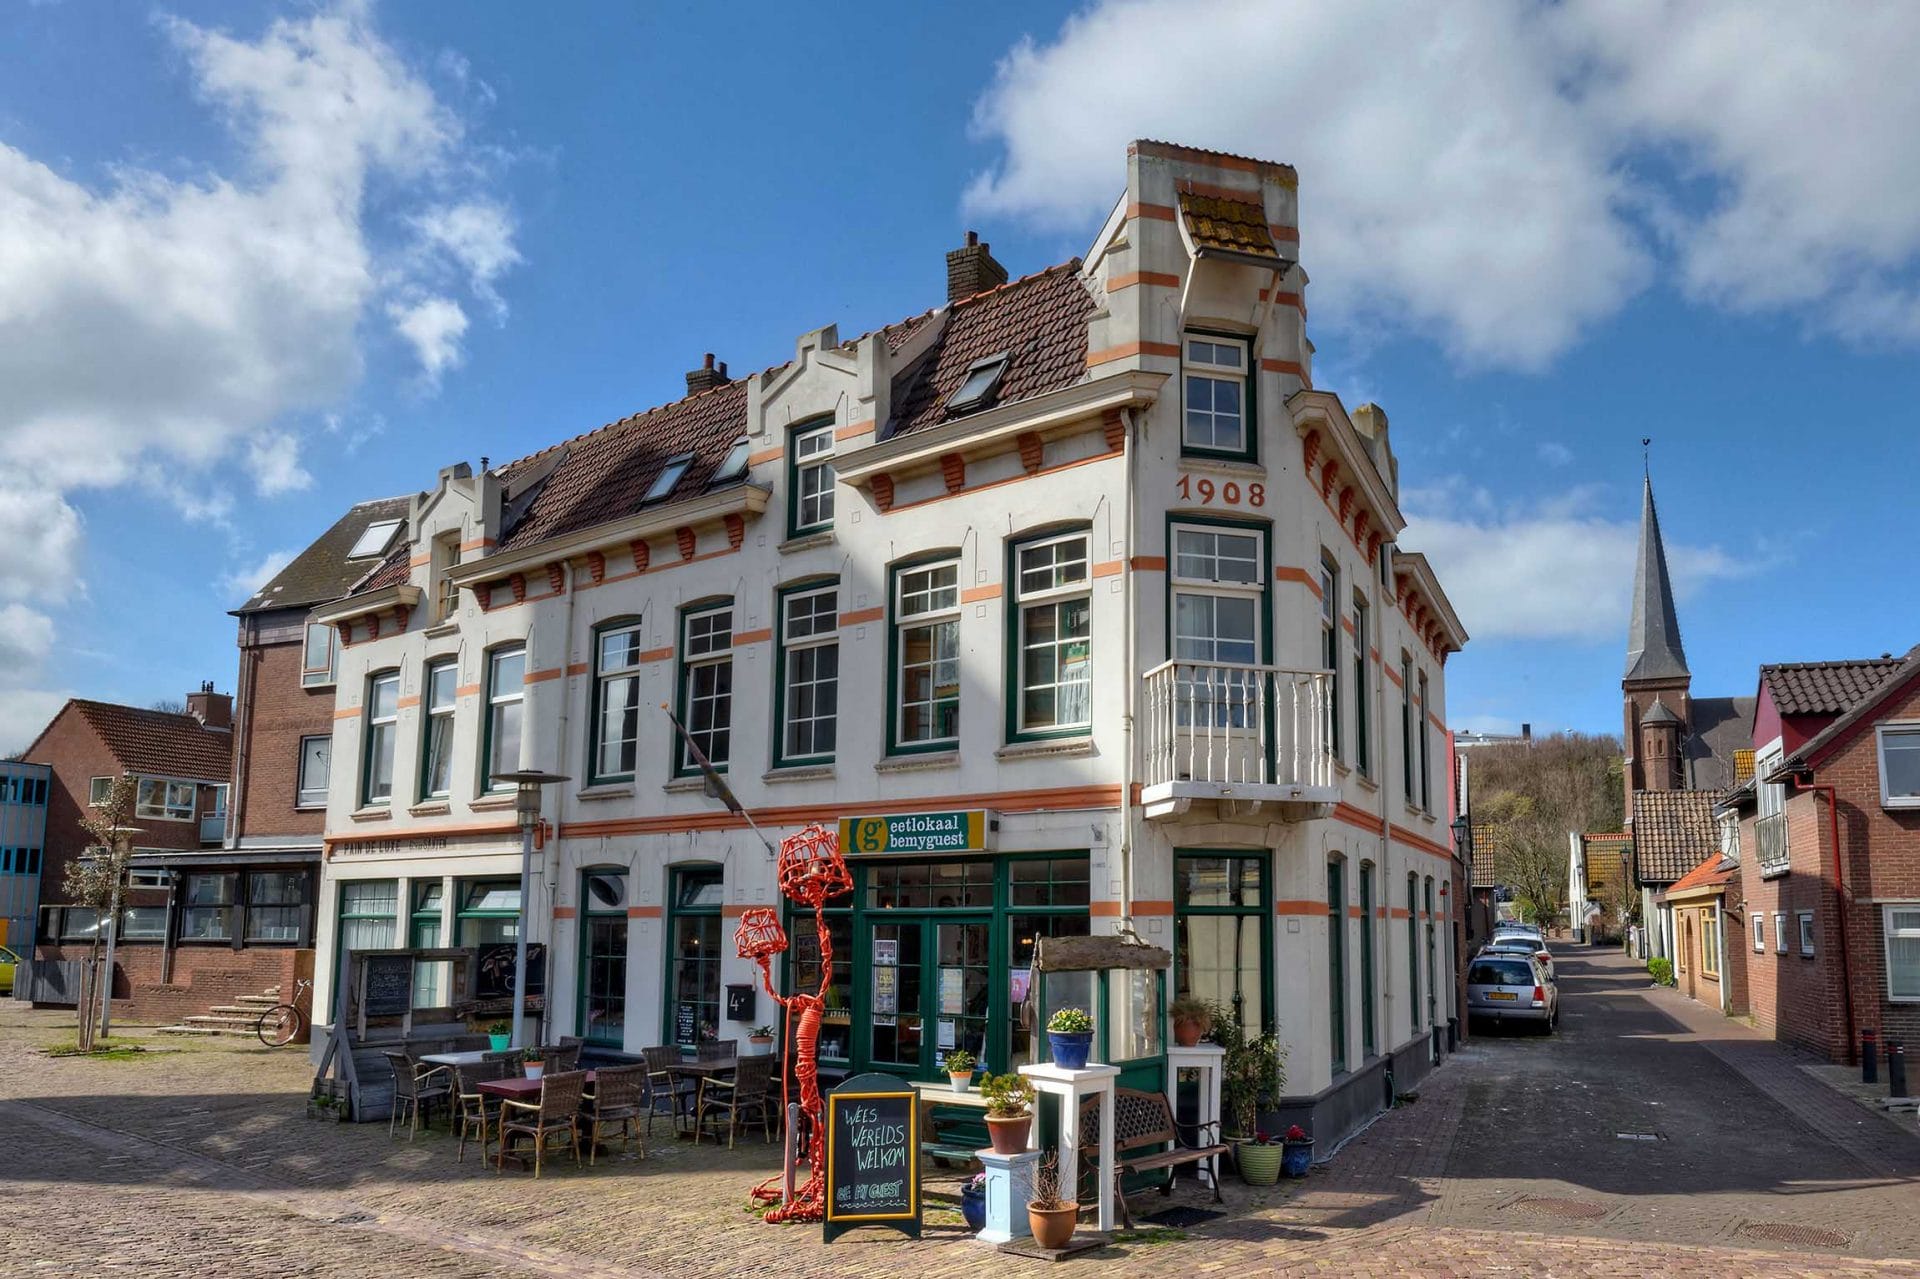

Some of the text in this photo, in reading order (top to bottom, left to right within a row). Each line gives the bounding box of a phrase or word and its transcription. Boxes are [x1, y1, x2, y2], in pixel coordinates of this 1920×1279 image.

[1176, 474, 1265, 508] 1908
[890, 815, 959, 833] eetlokaal
[344, 841, 362, 855] PAIN
[365, 841, 376, 854] DE
[379, 839, 401, 852] LUXE
[890, 831, 964, 850] bemyguest
[845, 1105, 877, 1126] WEES
[851, 1125, 905, 1147] WERELDS
[857, 1146, 905, 1171] WELKOM
[868, 1180, 903, 1199] GUEST
